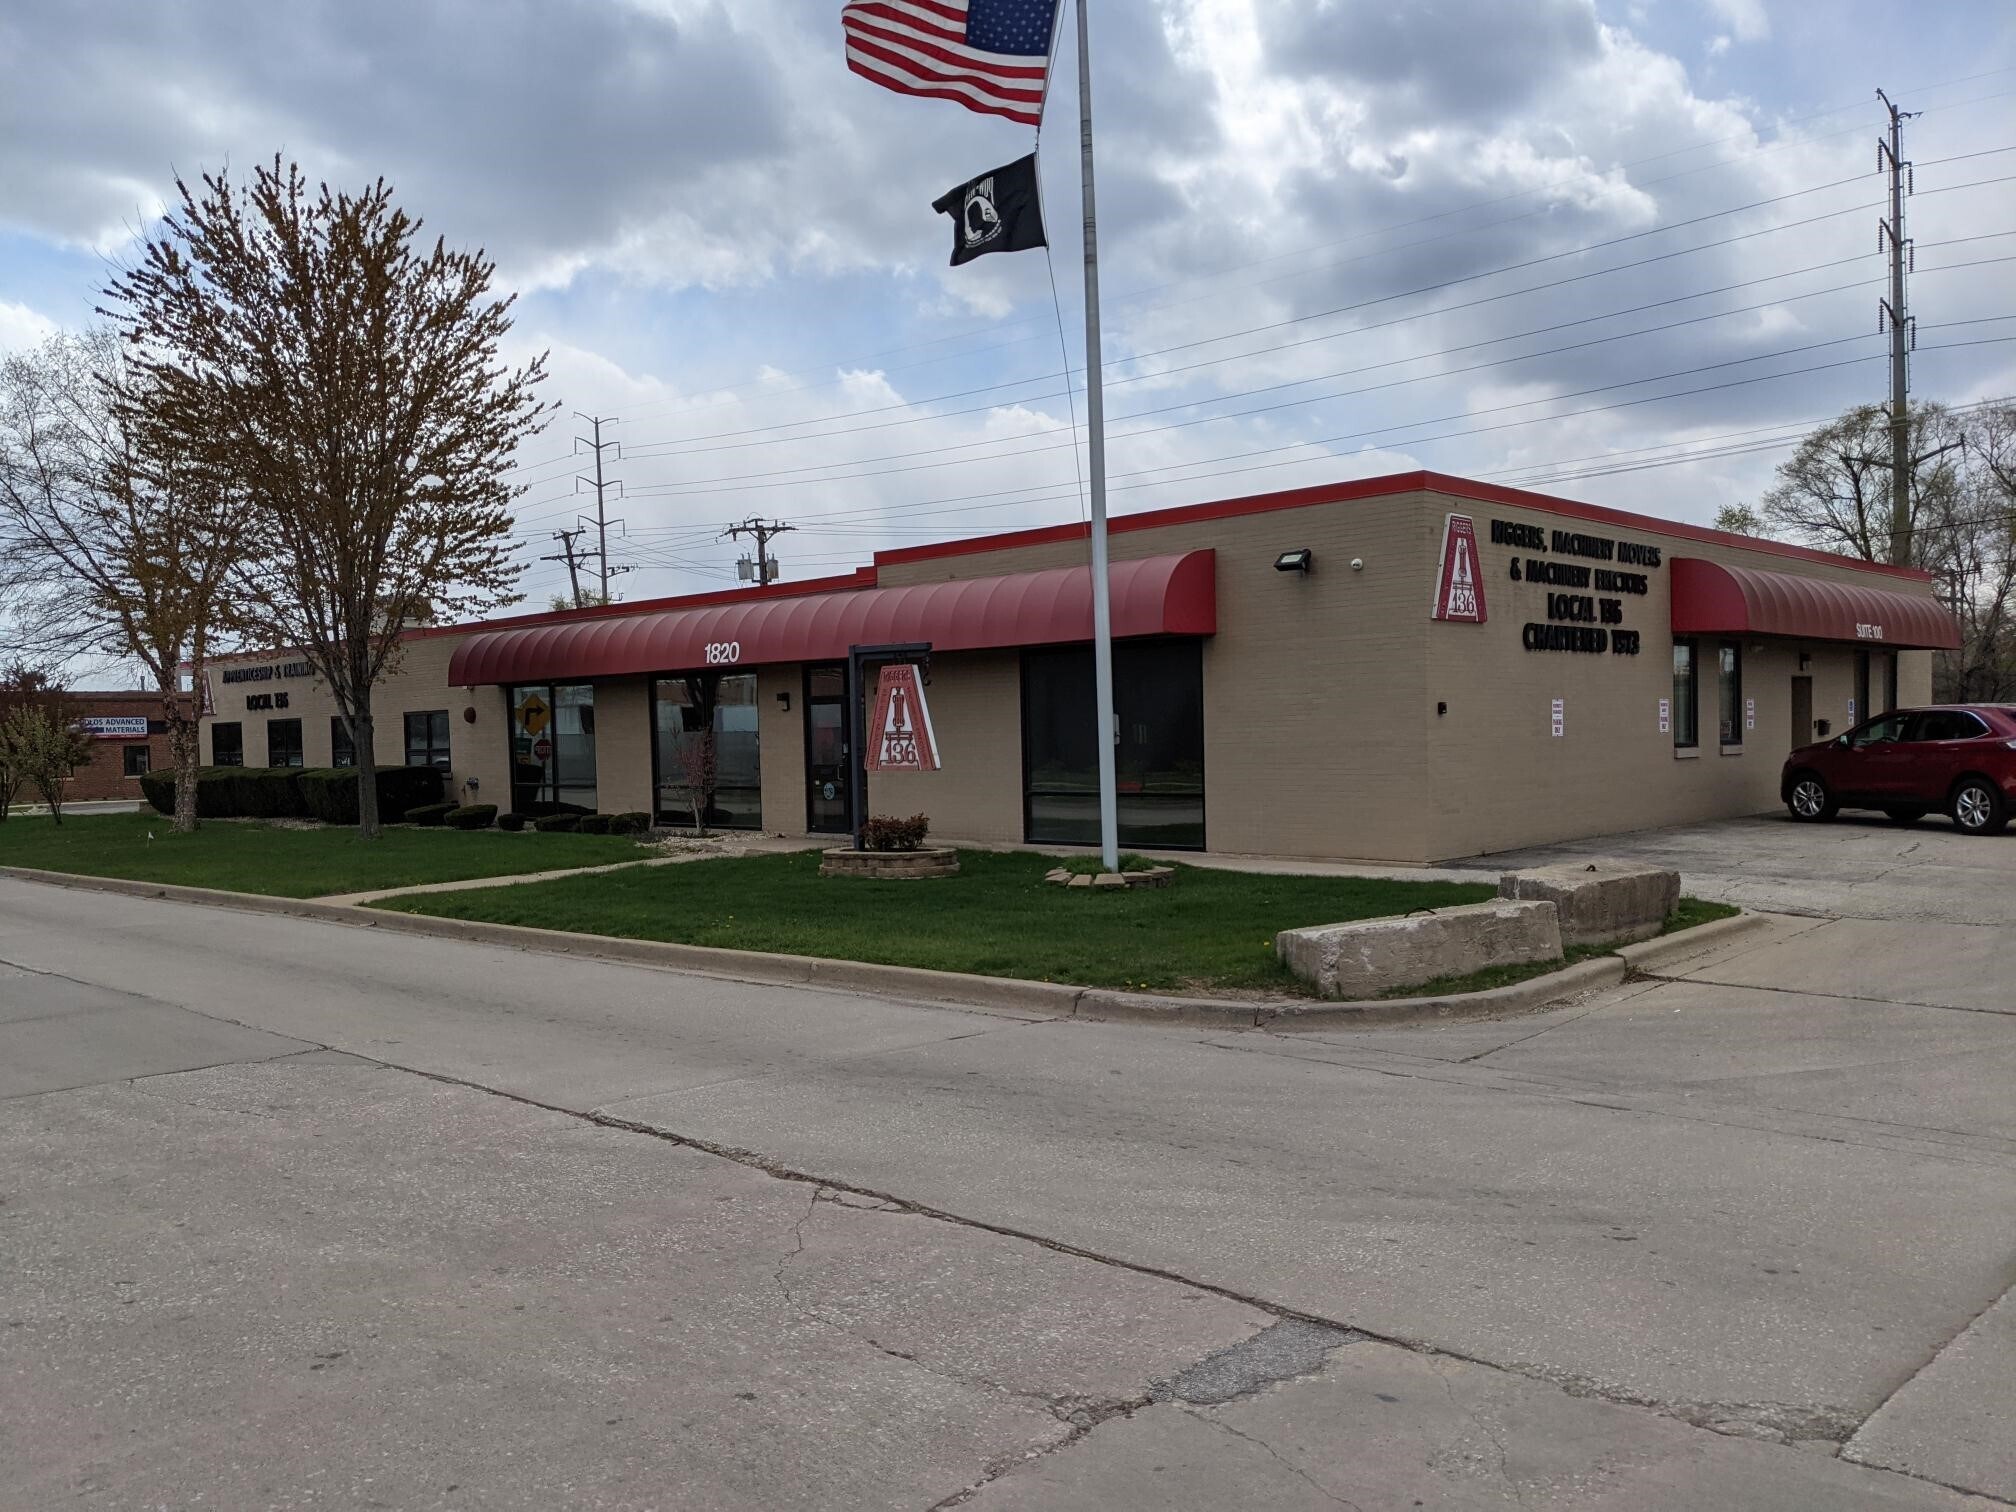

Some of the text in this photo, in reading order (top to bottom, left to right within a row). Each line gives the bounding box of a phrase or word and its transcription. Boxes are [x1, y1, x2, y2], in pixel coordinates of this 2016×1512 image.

[1491, 519, 1548, 552] RIGGERS,
[1552, 530, 1615, 561] MACHINERY
[1617, 541, 1662, 568] MOVERS
[1510, 557, 1522, 581] &
[1526, 559, 1592, 588] MACHINERY
[1452, 592, 1475, 614] 136
[1547, 592, 1622, 624] LOCAL 136
[1523, 622, 1608, 653] CHARTERED
[1856, 623, 1883, 639] SUITE 100
[704, 641, 740, 664] 1820
[246, 694, 273, 711] LOCAL
[885, 742, 916, 764] 136
